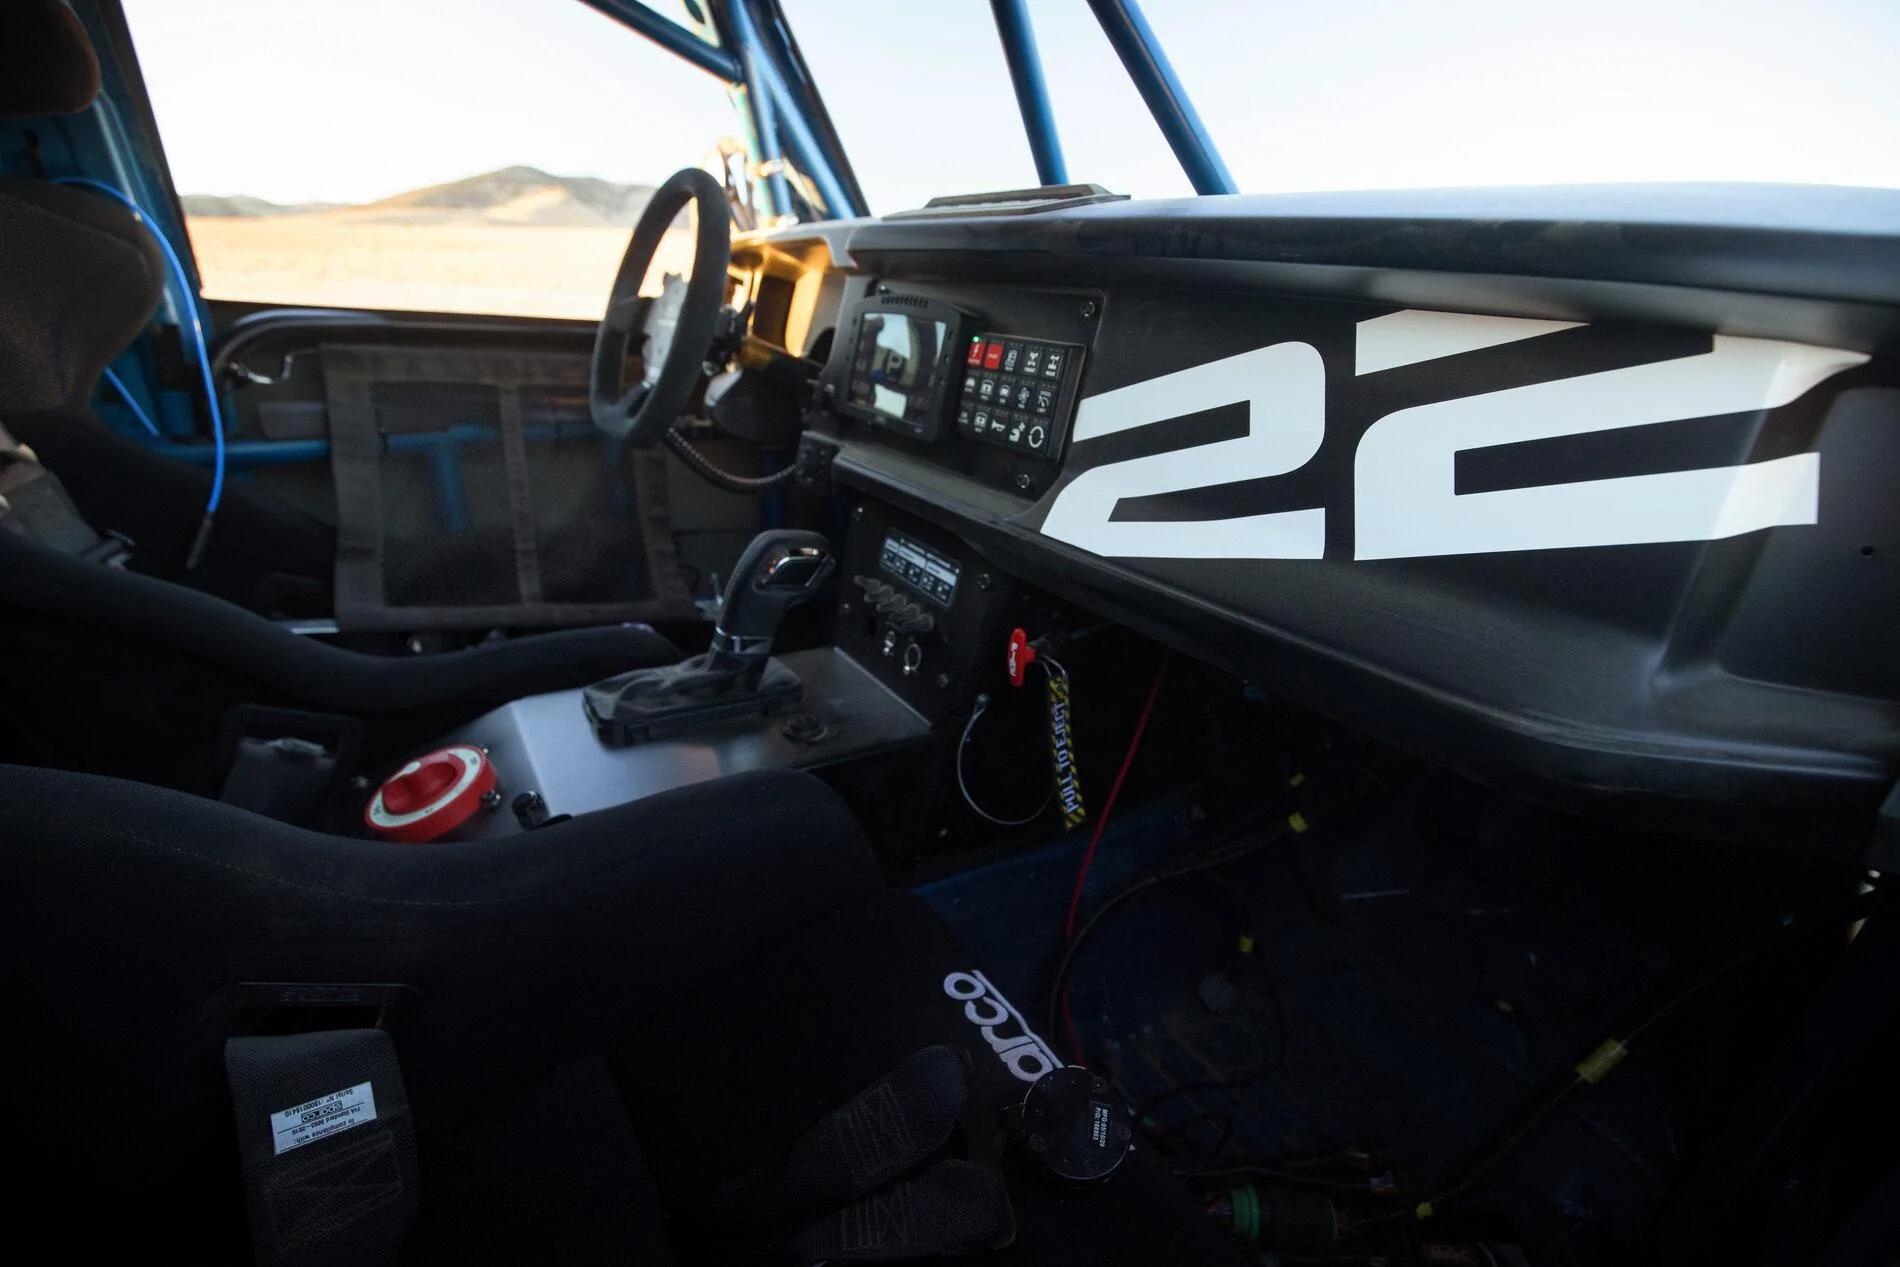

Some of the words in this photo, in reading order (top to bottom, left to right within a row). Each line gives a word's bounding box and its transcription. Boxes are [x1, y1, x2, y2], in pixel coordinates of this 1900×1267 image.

[1041, 309, 1872, 561] 22
[1054, 703, 1066, 748] EJECT
[1057, 750, 1070, 772] TO
[1062, 772, 1079, 812] PULL
[943, 969, 1064, 1081] arco
